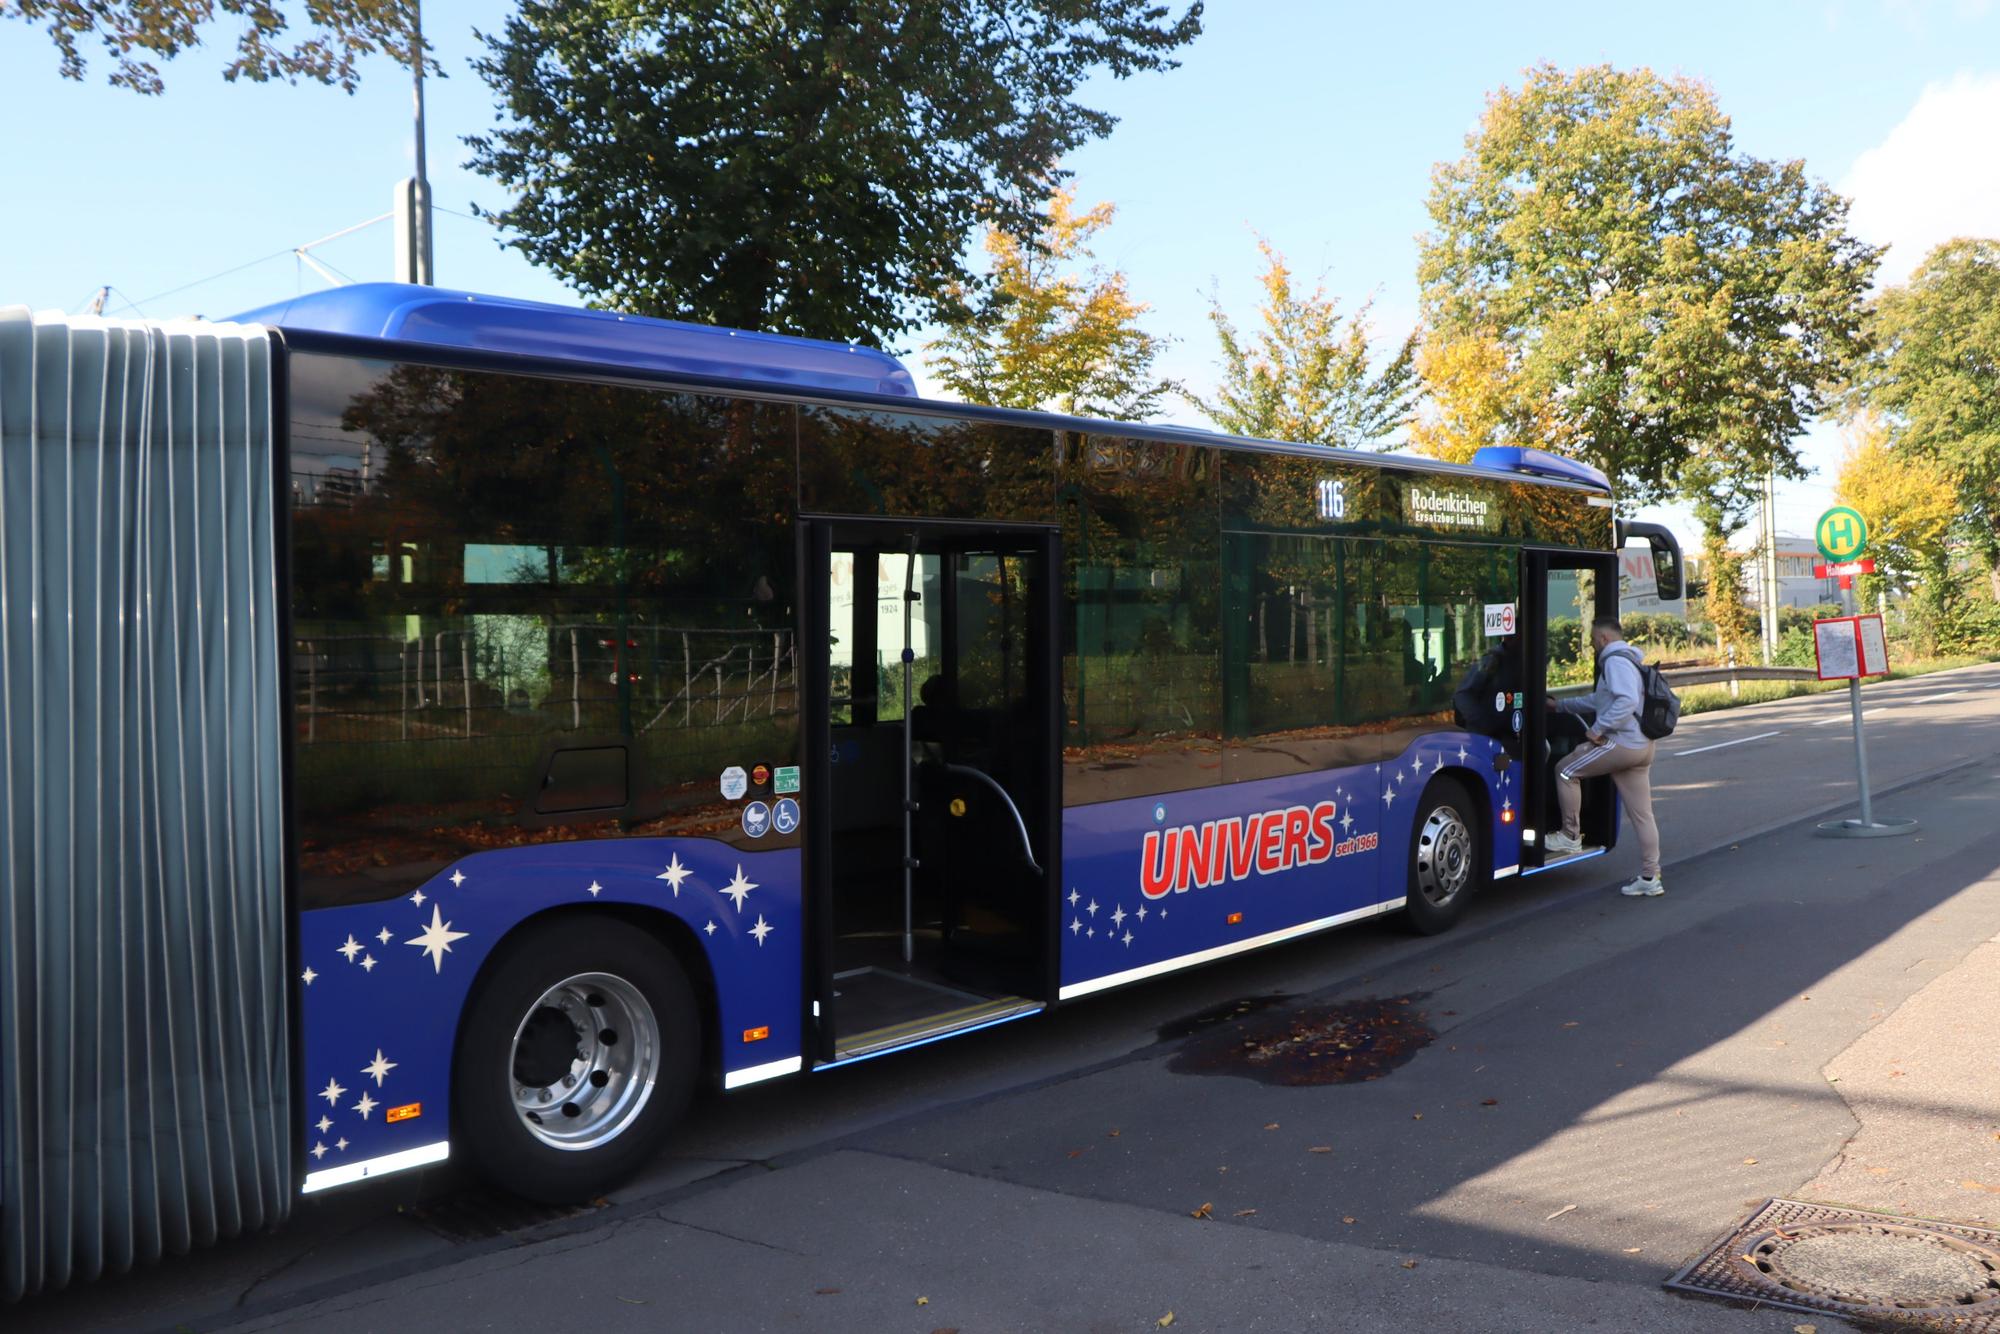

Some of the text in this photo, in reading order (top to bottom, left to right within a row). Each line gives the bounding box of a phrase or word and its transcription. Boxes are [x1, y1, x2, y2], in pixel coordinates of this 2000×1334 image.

[1318, 479, 1344, 518] 116
[1415, 511, 1484, 526] Ersatzbus Linie 16
[1829, 518, 1853, 550] H
[1486, 612, 1502, 628] KVB
[1140, 800, 1337, 900] UNIVERS
[1335, 832, 1378, 857] seit 1966
